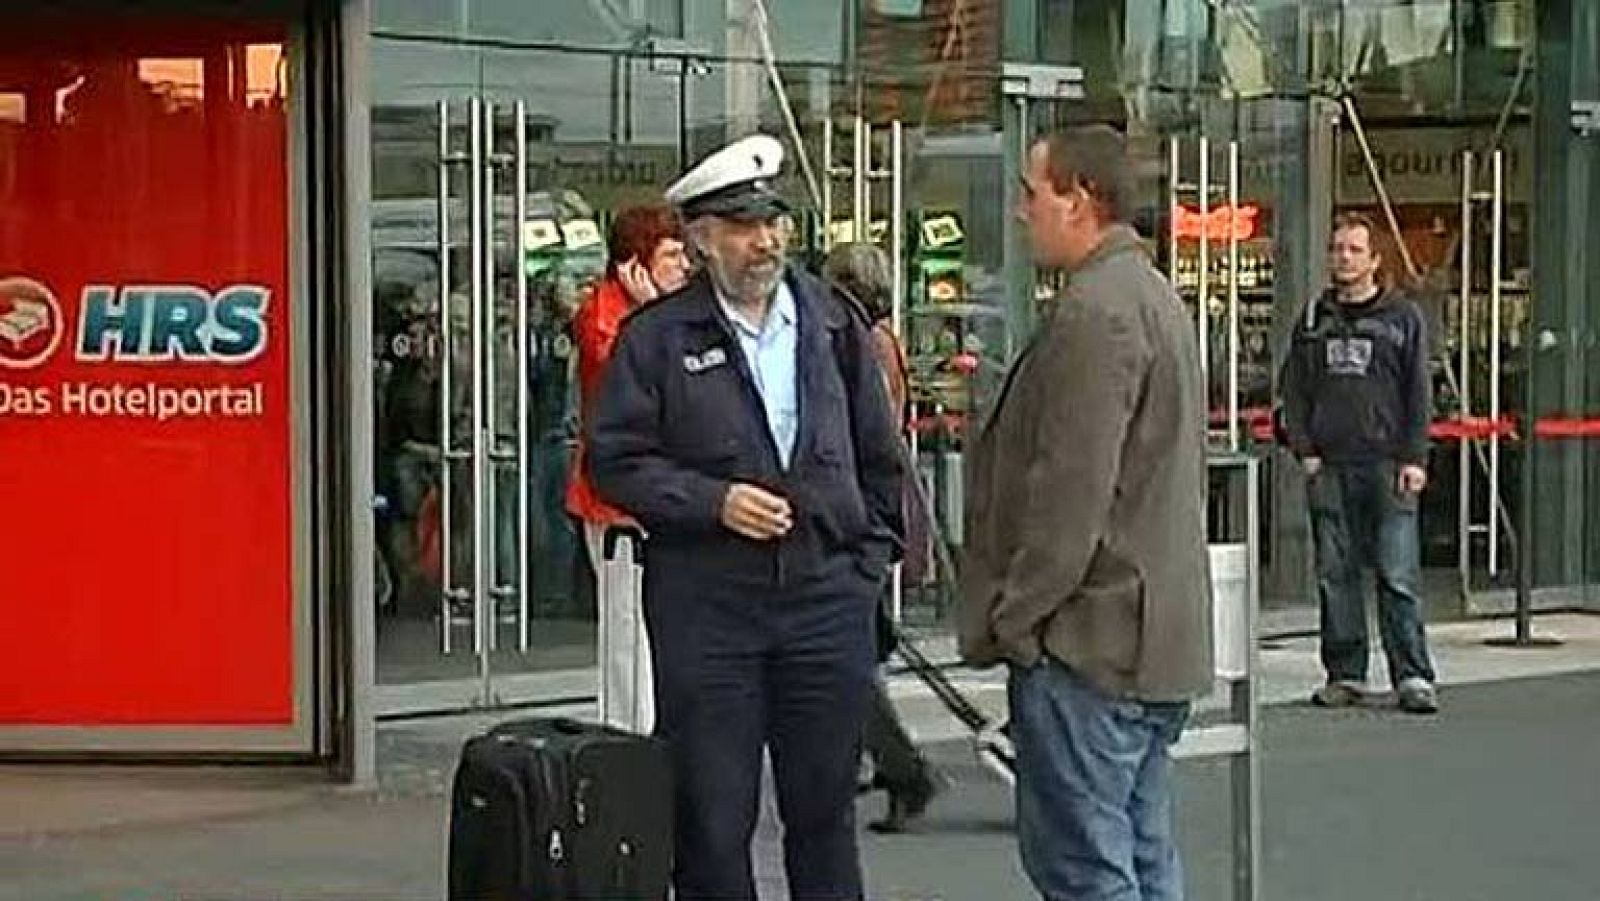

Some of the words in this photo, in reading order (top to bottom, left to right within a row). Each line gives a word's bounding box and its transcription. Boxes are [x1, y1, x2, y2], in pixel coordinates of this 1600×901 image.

[76, 285, 271, 361] HRS
[0, 383, 51, 414] Das
[62, 382, 263, 420] Hotelportal
